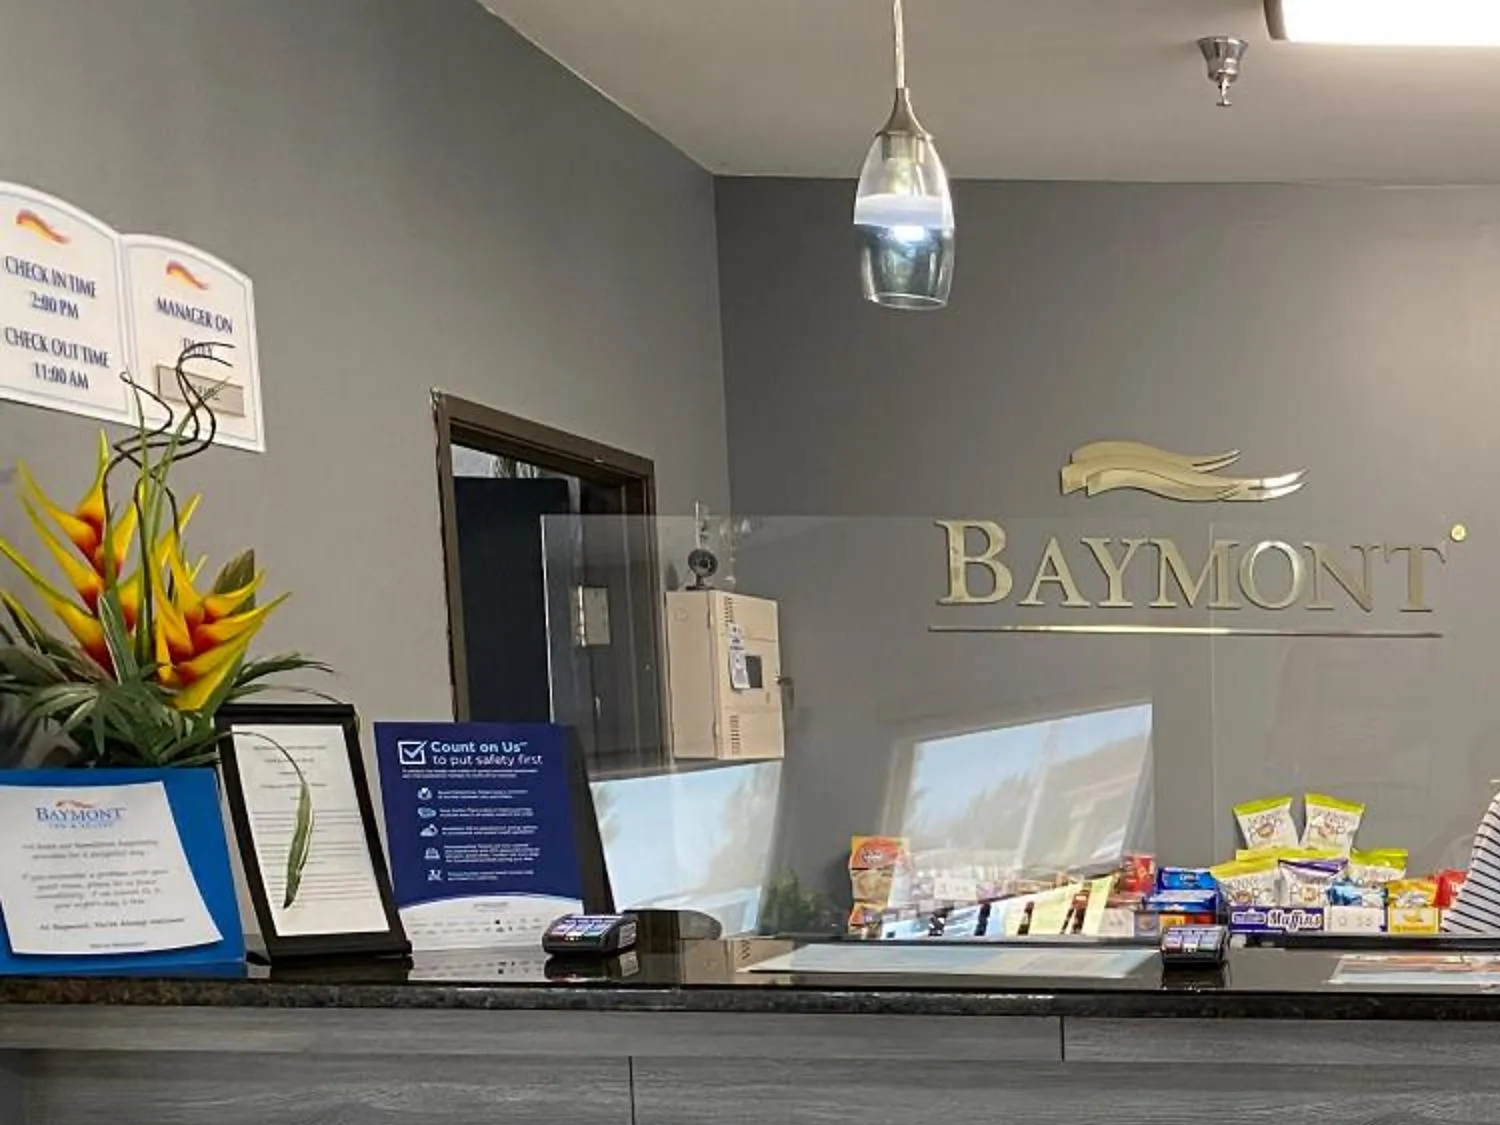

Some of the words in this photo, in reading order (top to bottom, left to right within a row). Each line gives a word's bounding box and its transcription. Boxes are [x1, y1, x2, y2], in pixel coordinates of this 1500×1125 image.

[5, 255, 49, 287] CHECK
[51, 267, 67, 288] IN
[68, 272, 97, 298] TIME
[30, 293, 57, 314] 2:00
[58, 298, 79, 319] PM
[157, 296, 213, 330] MANAGER
[214, 313, 234, 334] ON
[5, 326, 49, 353] CHECK
[50, 337, 79, 360] OUT
[81, 345, 111, 368] TIME
[33, 362, 67, 384] 11:00
[68, 369, 90, 390] AM
[935, 519, 1447, 613] BAYMONT
[430, 740, 476, 753] Count
[479, 743, 499, 753] on
[433, 755, 447, 765] to
[451, 754, 472, 767] put
[475, 753, 516, 767] safety
[518, 752, 544, 766] first
[35, 806, 124, 823] BAYMONT
